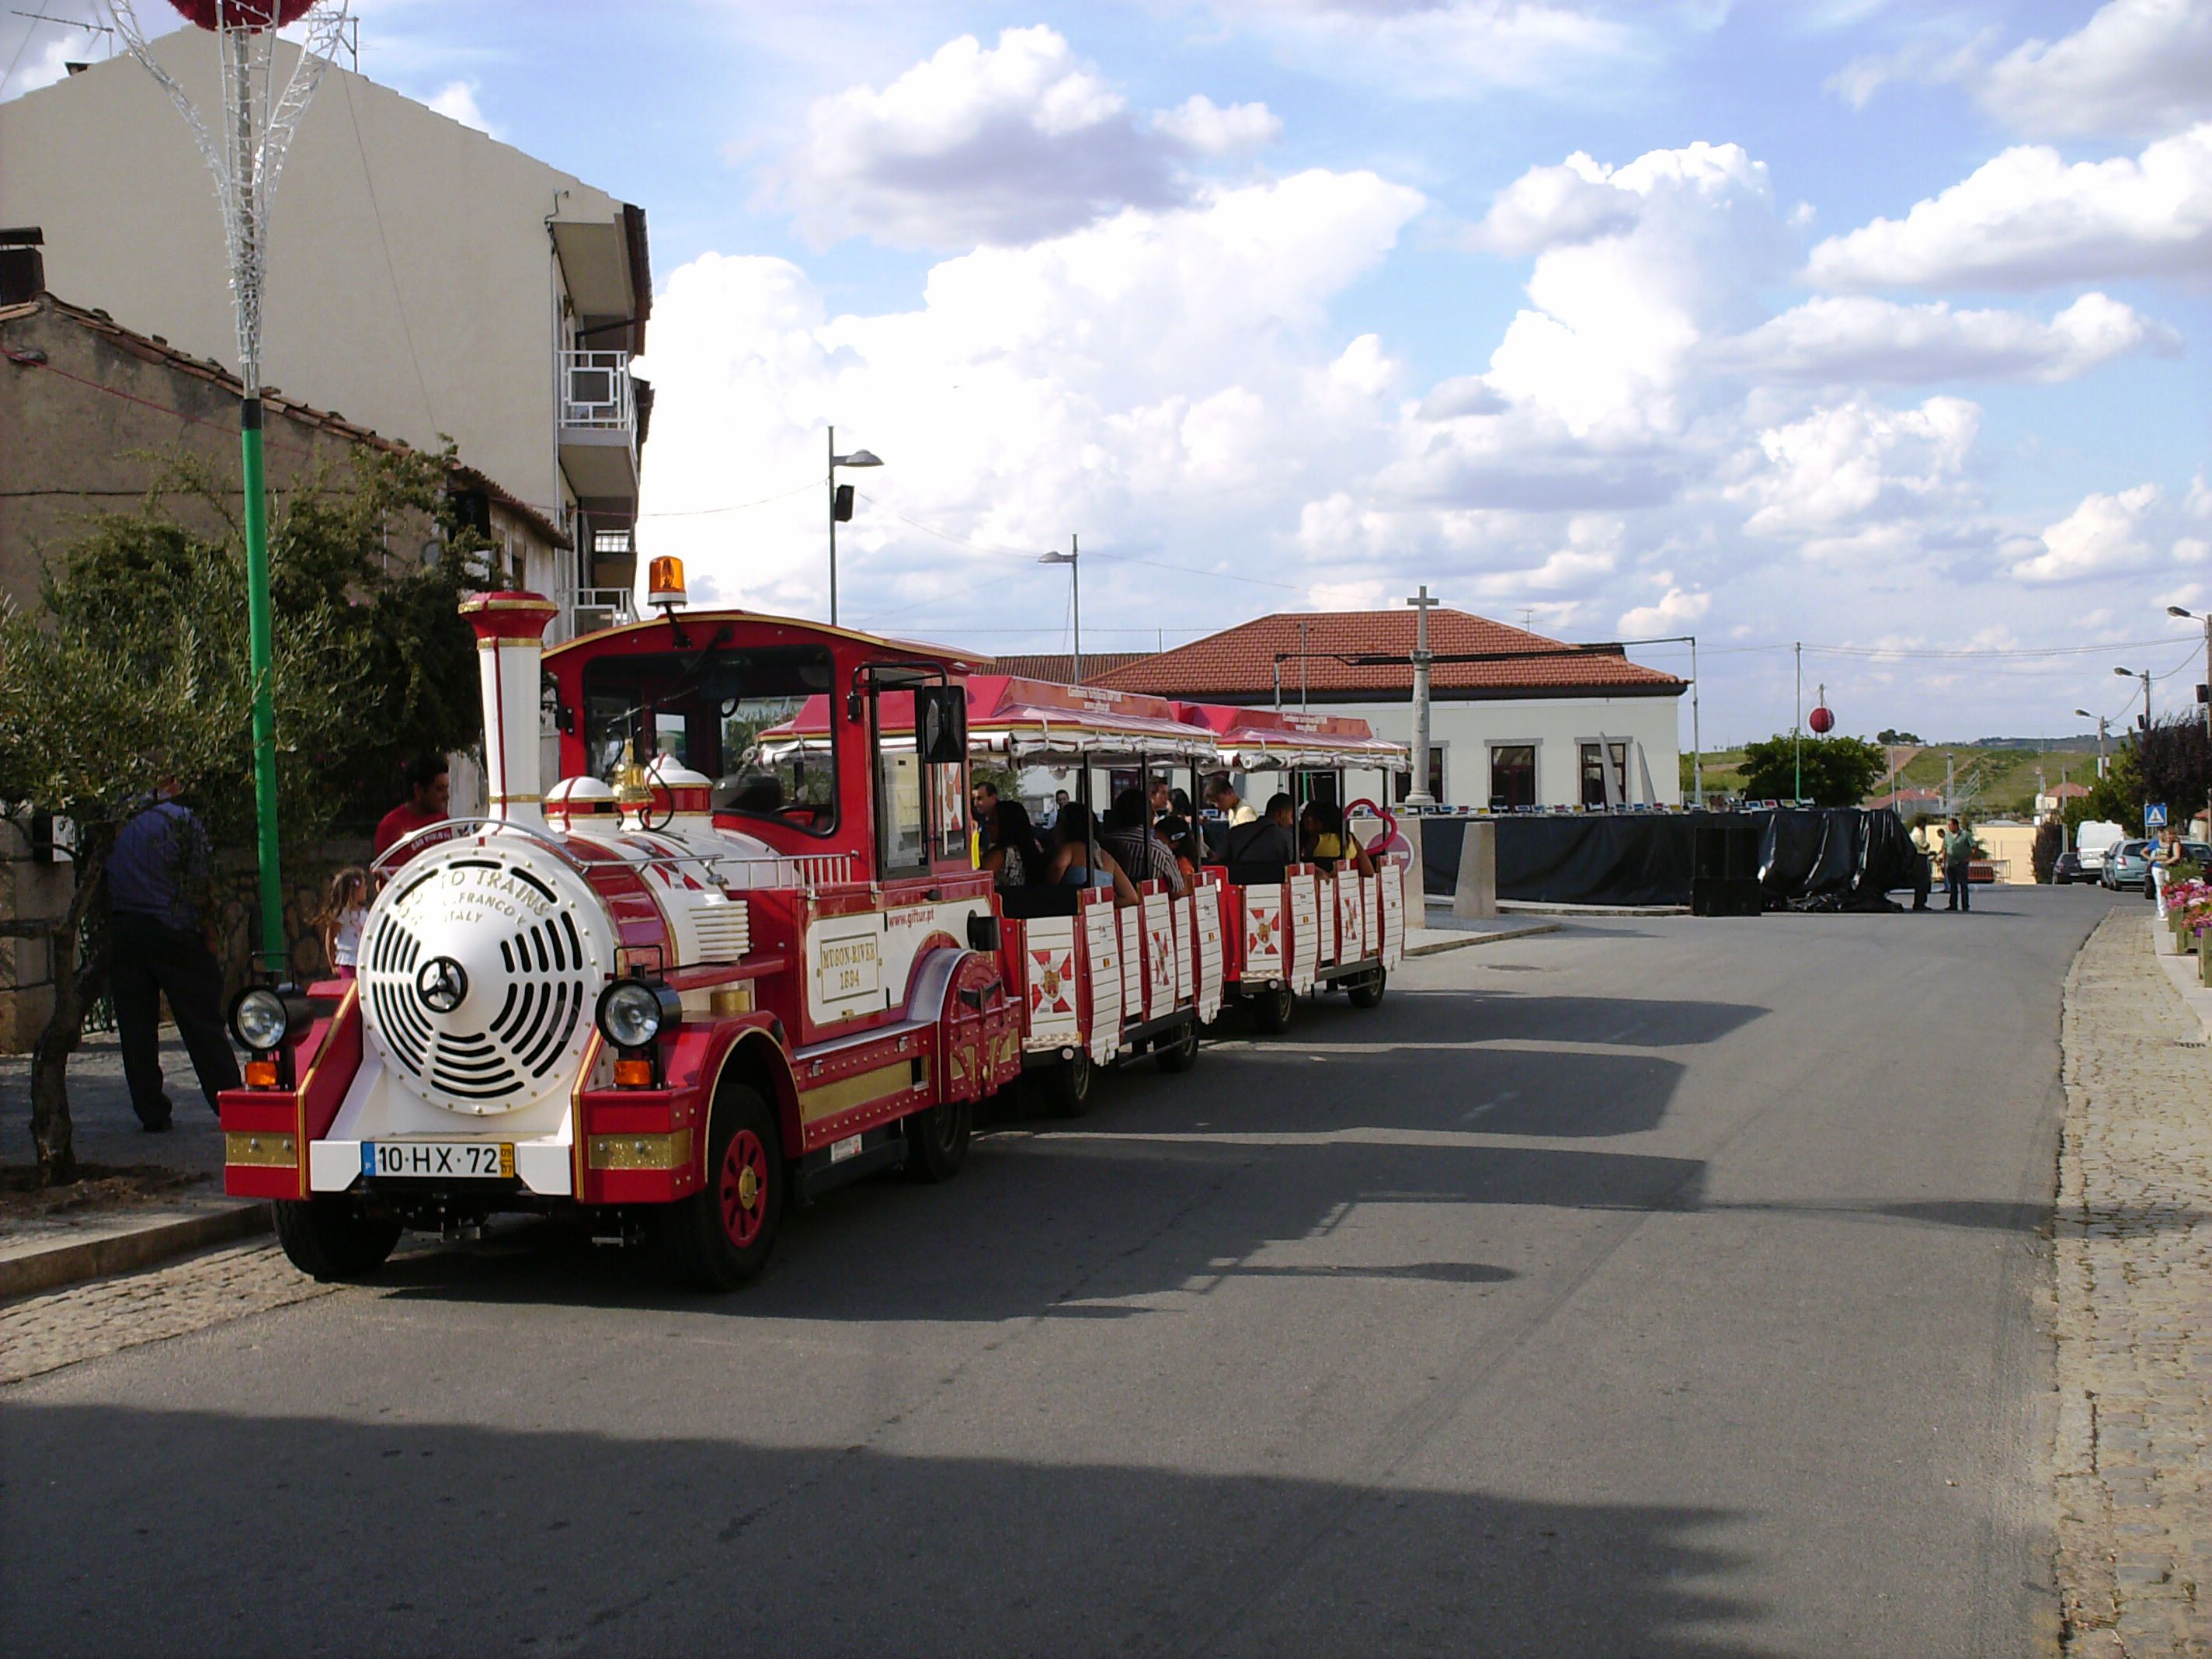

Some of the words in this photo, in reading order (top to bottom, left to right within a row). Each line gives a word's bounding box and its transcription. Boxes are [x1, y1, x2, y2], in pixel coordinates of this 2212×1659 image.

[477, 868, 551, 916] TRAINS
[889, 908, 934, 928] www.giftur.pt
[840, 969, 861, 990] 1894
